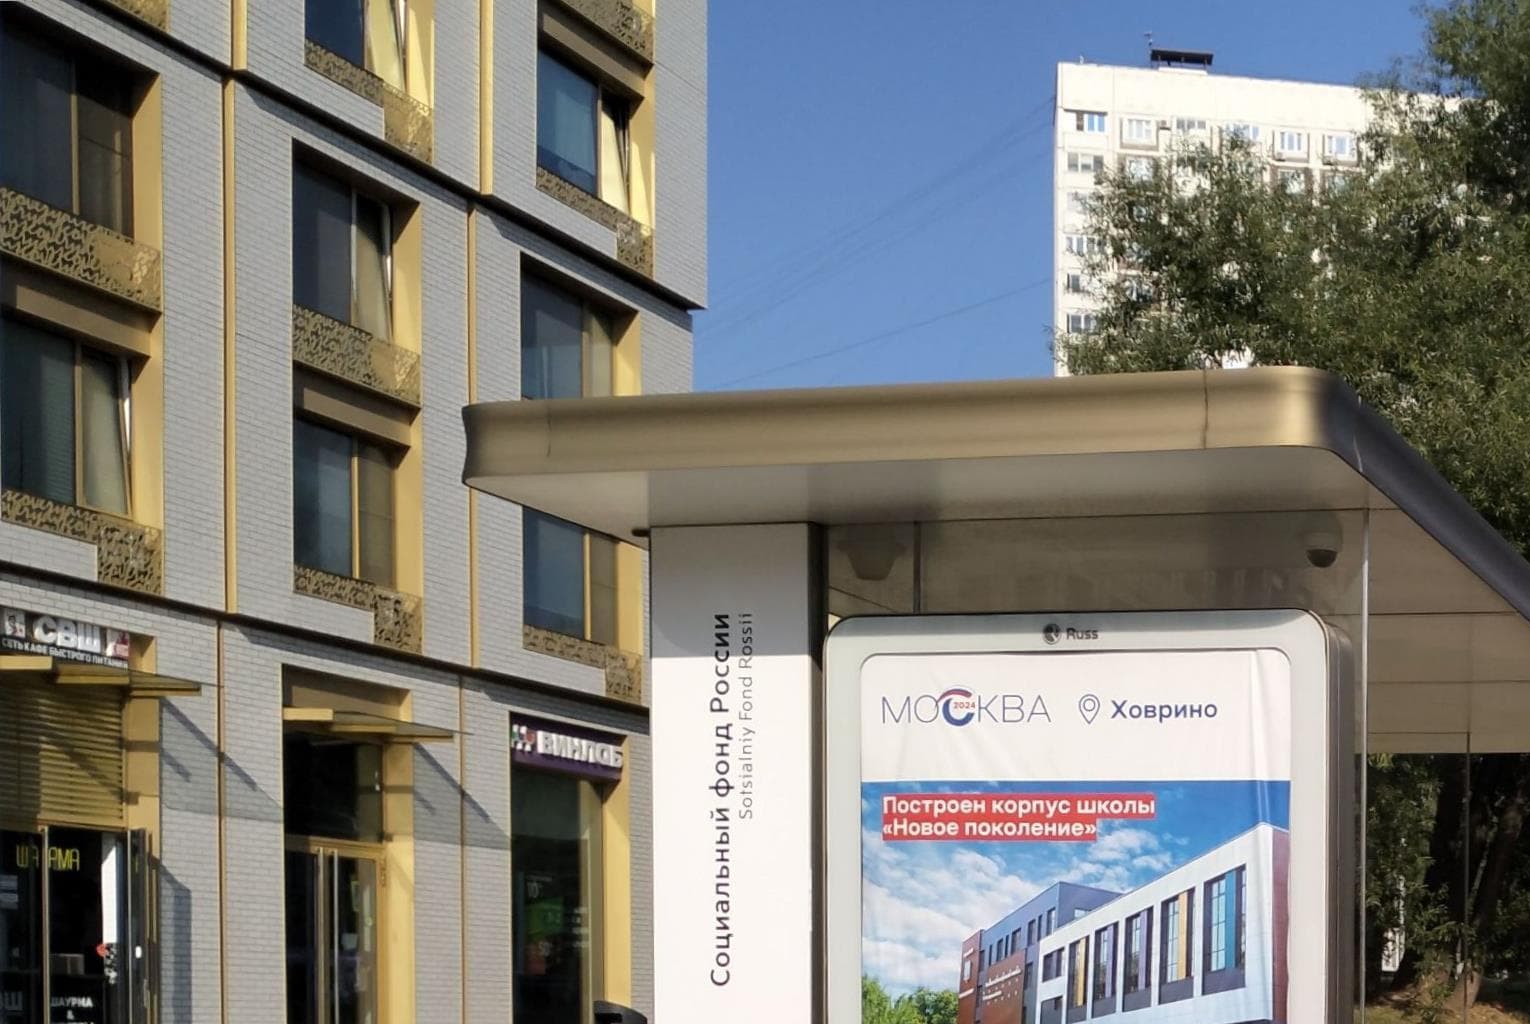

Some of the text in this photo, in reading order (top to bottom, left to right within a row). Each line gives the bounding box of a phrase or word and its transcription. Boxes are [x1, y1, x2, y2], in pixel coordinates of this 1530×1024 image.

[33, 615, 101, 653] СВШ
[1065, 627, 1099, 641] Russ
[25, 642, 48, 655] КАФЕ
[49, 647, 91, 664] БЫСТРОГО
[739, 613, 755, 819] Sotsialniy Fond Rossii
[881, 688, 1051, 727] МОСКВА
[953, 700, 976, 710] 2024
[1111, 699, 1218, 723] Ховрино
[709, 614, 734, 986] Социальный фонд России
[883, 796, 1155, 818] Построен корпус школы
[883, 819, 1097, 837] «Новое поколение»
